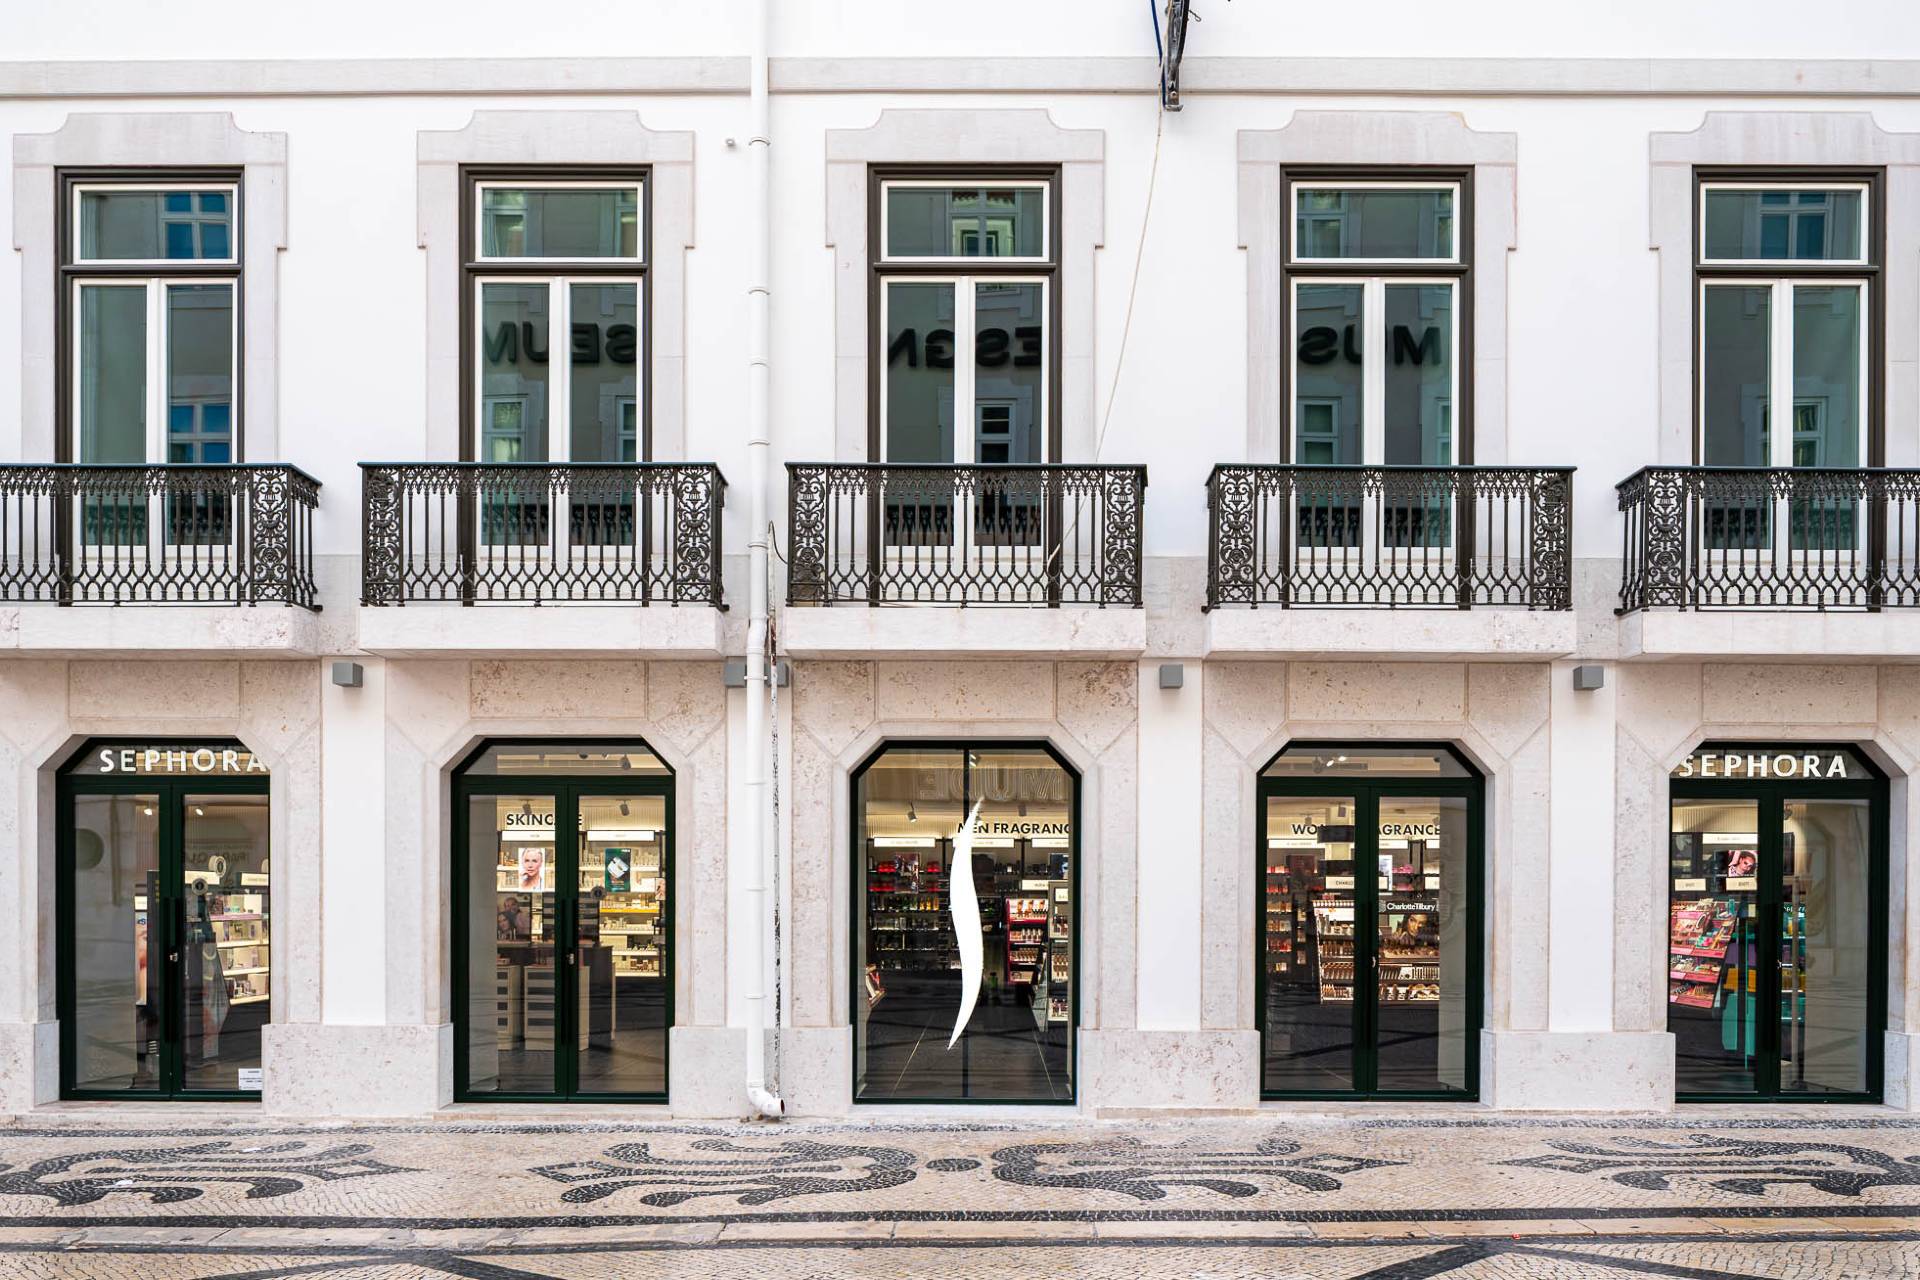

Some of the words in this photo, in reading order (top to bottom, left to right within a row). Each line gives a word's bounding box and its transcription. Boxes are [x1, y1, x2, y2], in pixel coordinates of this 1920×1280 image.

[100, 748, 267, 772] SEPHORA
[1678, 754, 1847, 778] SEPHORA
[506, 813, 582, 826] SKINCE
[1292, 823, 1328, 835] WO
